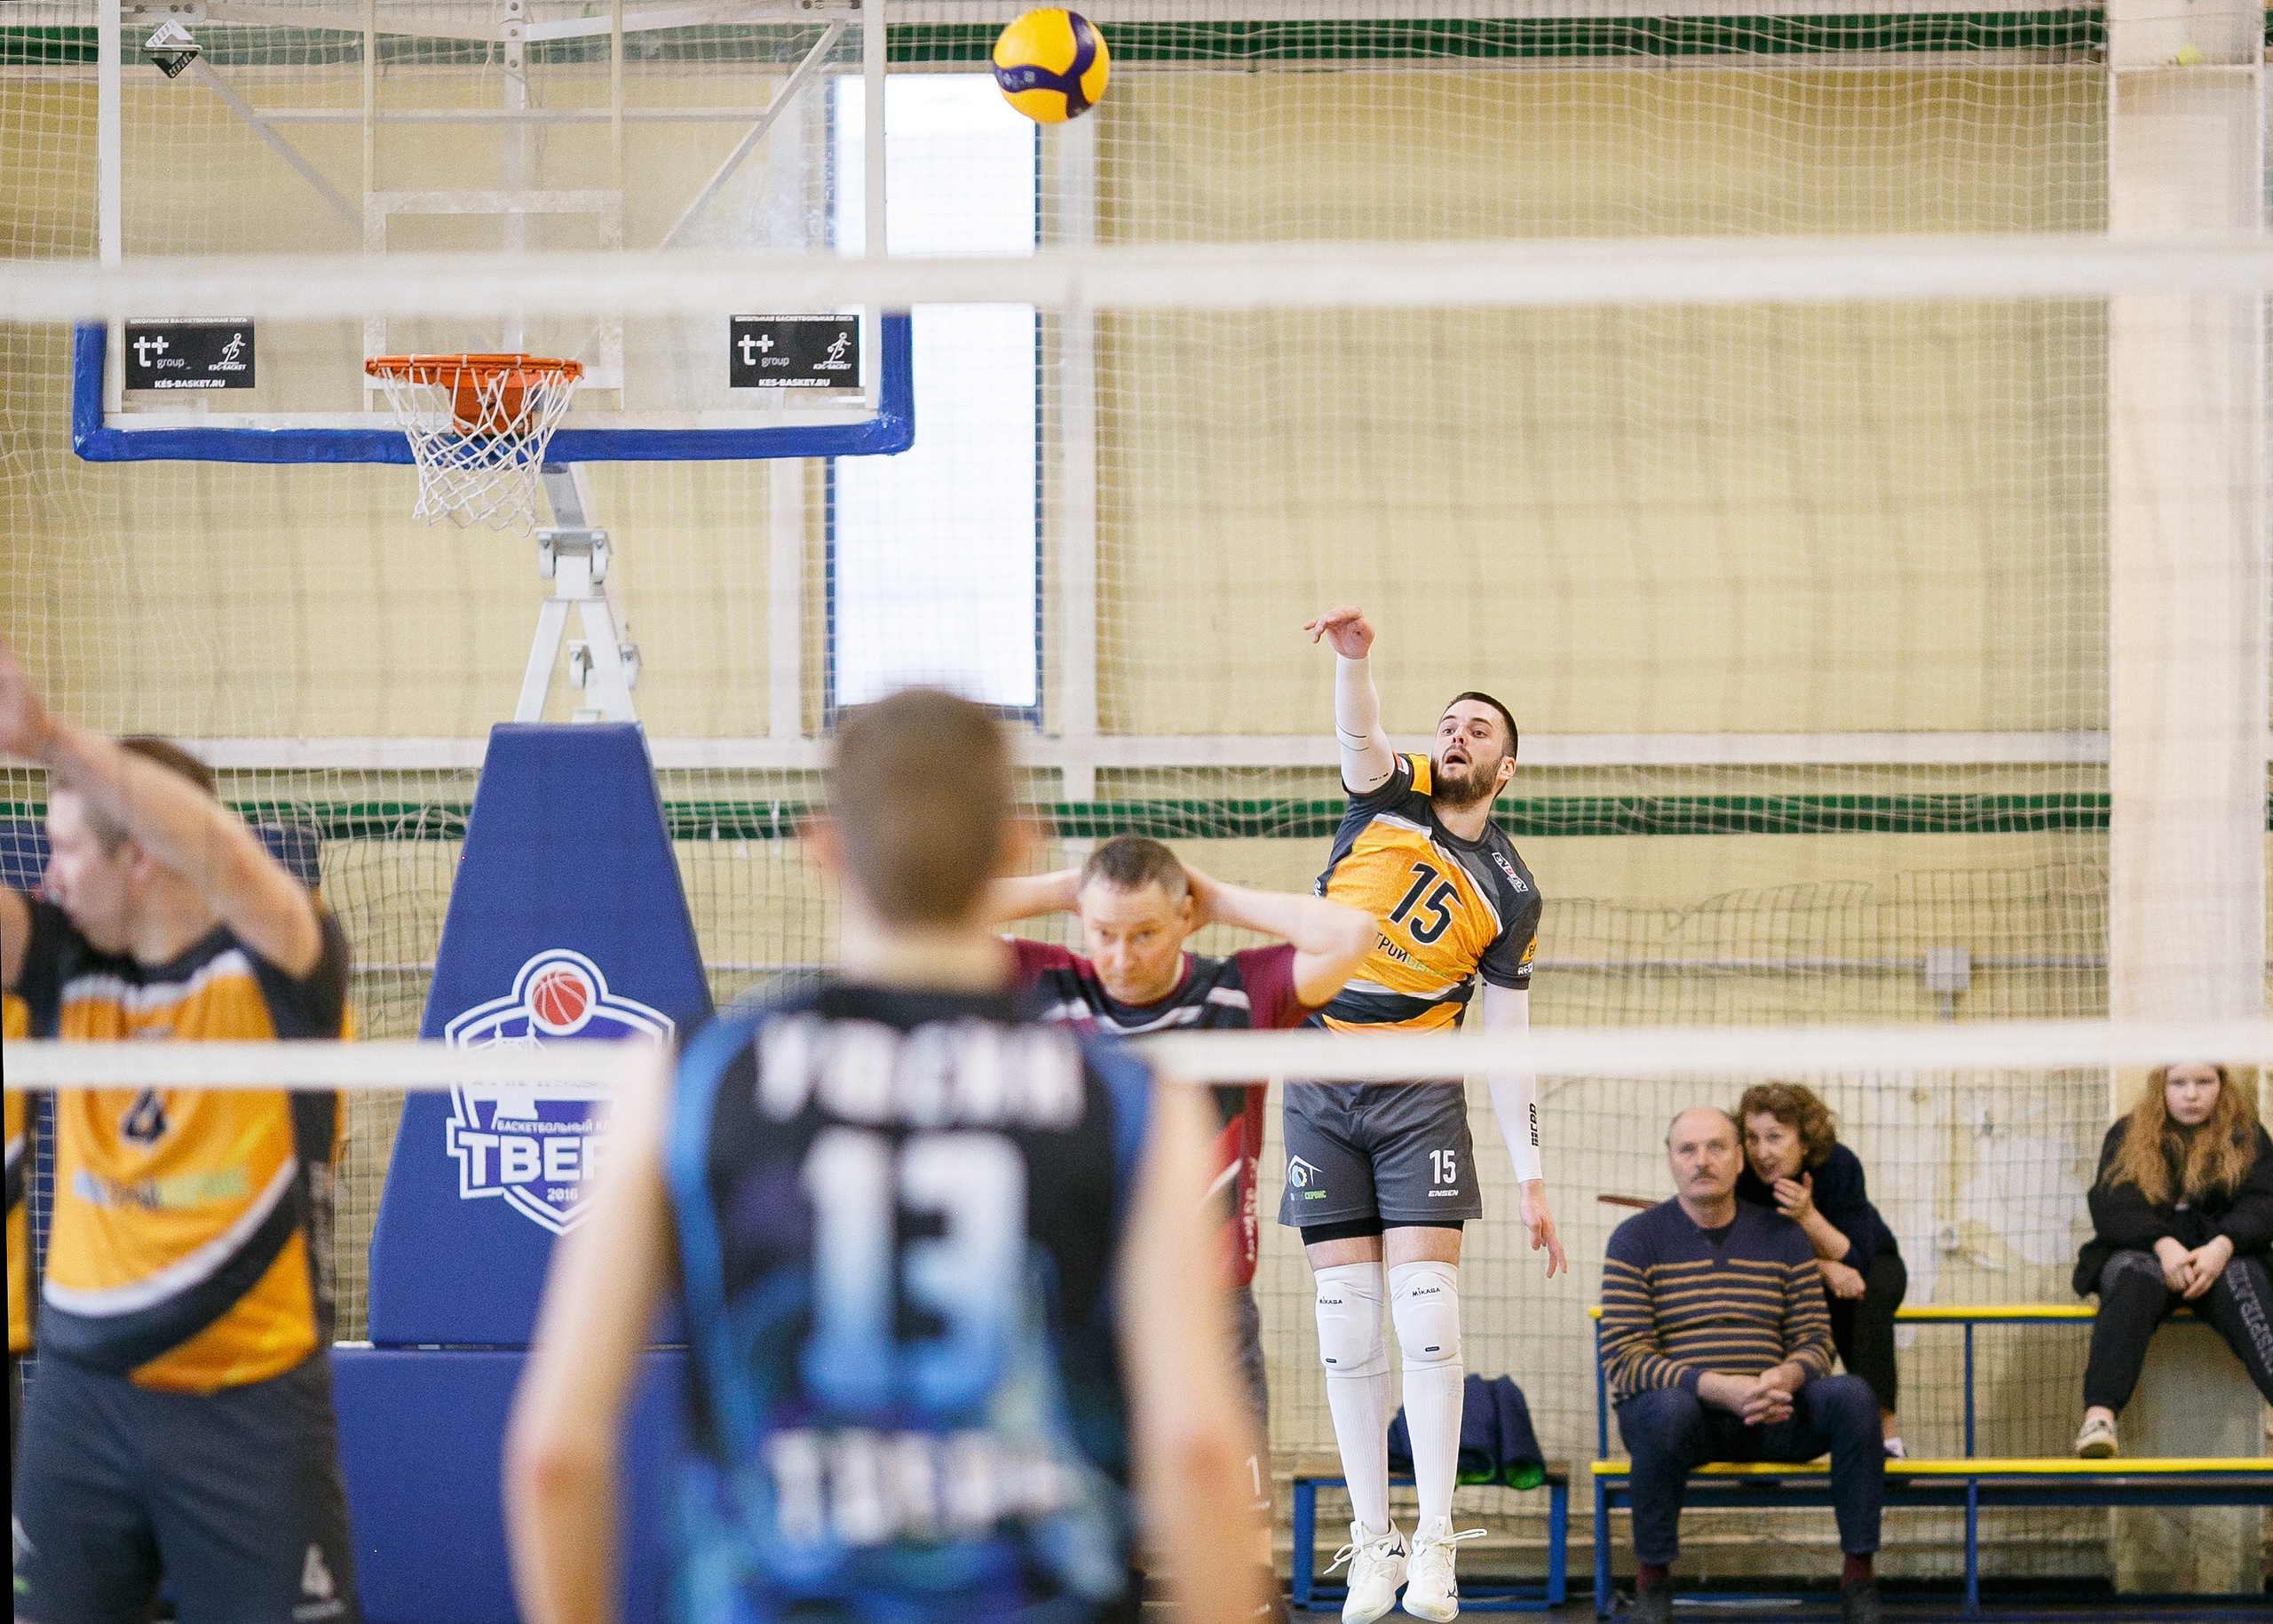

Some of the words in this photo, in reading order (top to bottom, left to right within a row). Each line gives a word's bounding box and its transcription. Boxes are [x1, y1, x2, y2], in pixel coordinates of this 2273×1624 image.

[156, 359, 185, 369] group
[761, 356, 790, 368] group
[154, 379, 226, 389] KES-BASKET.RU
[758, 378, 830, 387] KES-BASKET.RU
[1388, 861, 1463, 947] 15
[497, 1119, 593, 1134] БАСКЕТБОЛЬНЫЙ
[1429, 1150, 1457, 1184] 15
[547, 1187, 579, 1202] 2016
[803, 1125, 1028, 1407] 13
